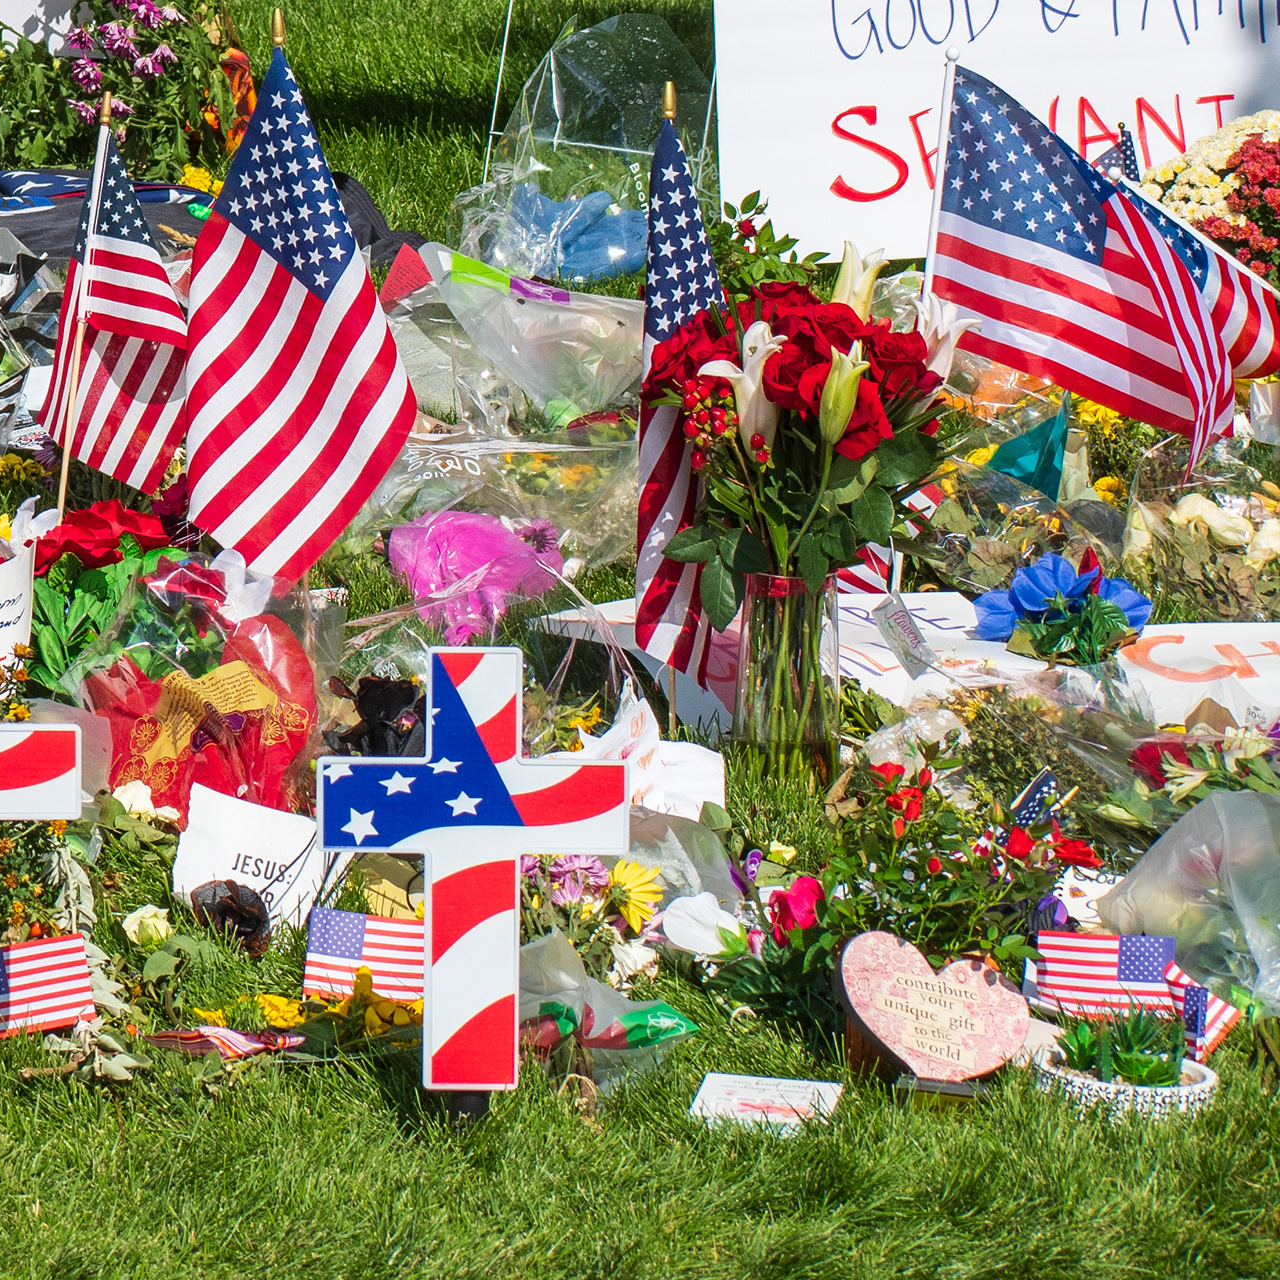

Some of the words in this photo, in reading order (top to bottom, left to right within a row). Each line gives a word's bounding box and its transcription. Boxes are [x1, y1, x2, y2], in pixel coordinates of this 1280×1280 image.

[885, 609, 921, 650] flowers
[232, 853, 292, 883] JESUS:
[897, 977, 979, 1001] contribute
[919, 993, 955, 1010] your
[884, 999, 938, 1021] unique
[949, 1016, 976, 1031] gift
[914, 1026, 928, 1036] to
[931, 1028, 952, 1040] the
[916, 1039, 961, 1061] world
